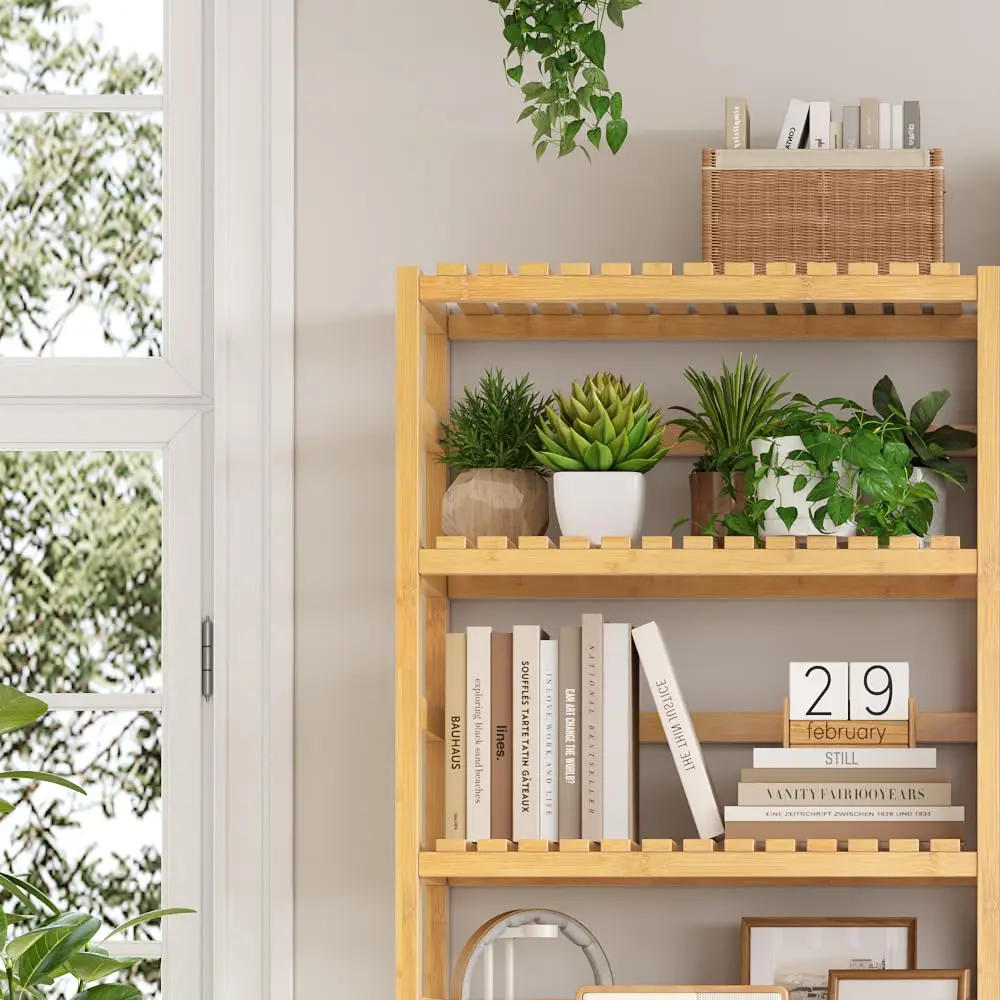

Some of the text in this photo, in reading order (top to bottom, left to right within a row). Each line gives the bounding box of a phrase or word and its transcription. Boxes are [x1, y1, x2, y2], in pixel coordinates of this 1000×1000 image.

[451, 715, 461, 770] BAUHAUS
[472, 678, 484, 804] exploring black sand beaches
[495, 725, 508, 761] lines.
[521, 660, 532, 813] SOUFFLÉS TARTE TATIN GÂTEAUX
[564, 688, 576, 784] CAN ART CHANGE THE WORLD?
[806, 721, 887, 744] february
[825, 751, 859, 765] STILL
[767, 788, 816, 800] VANITY
